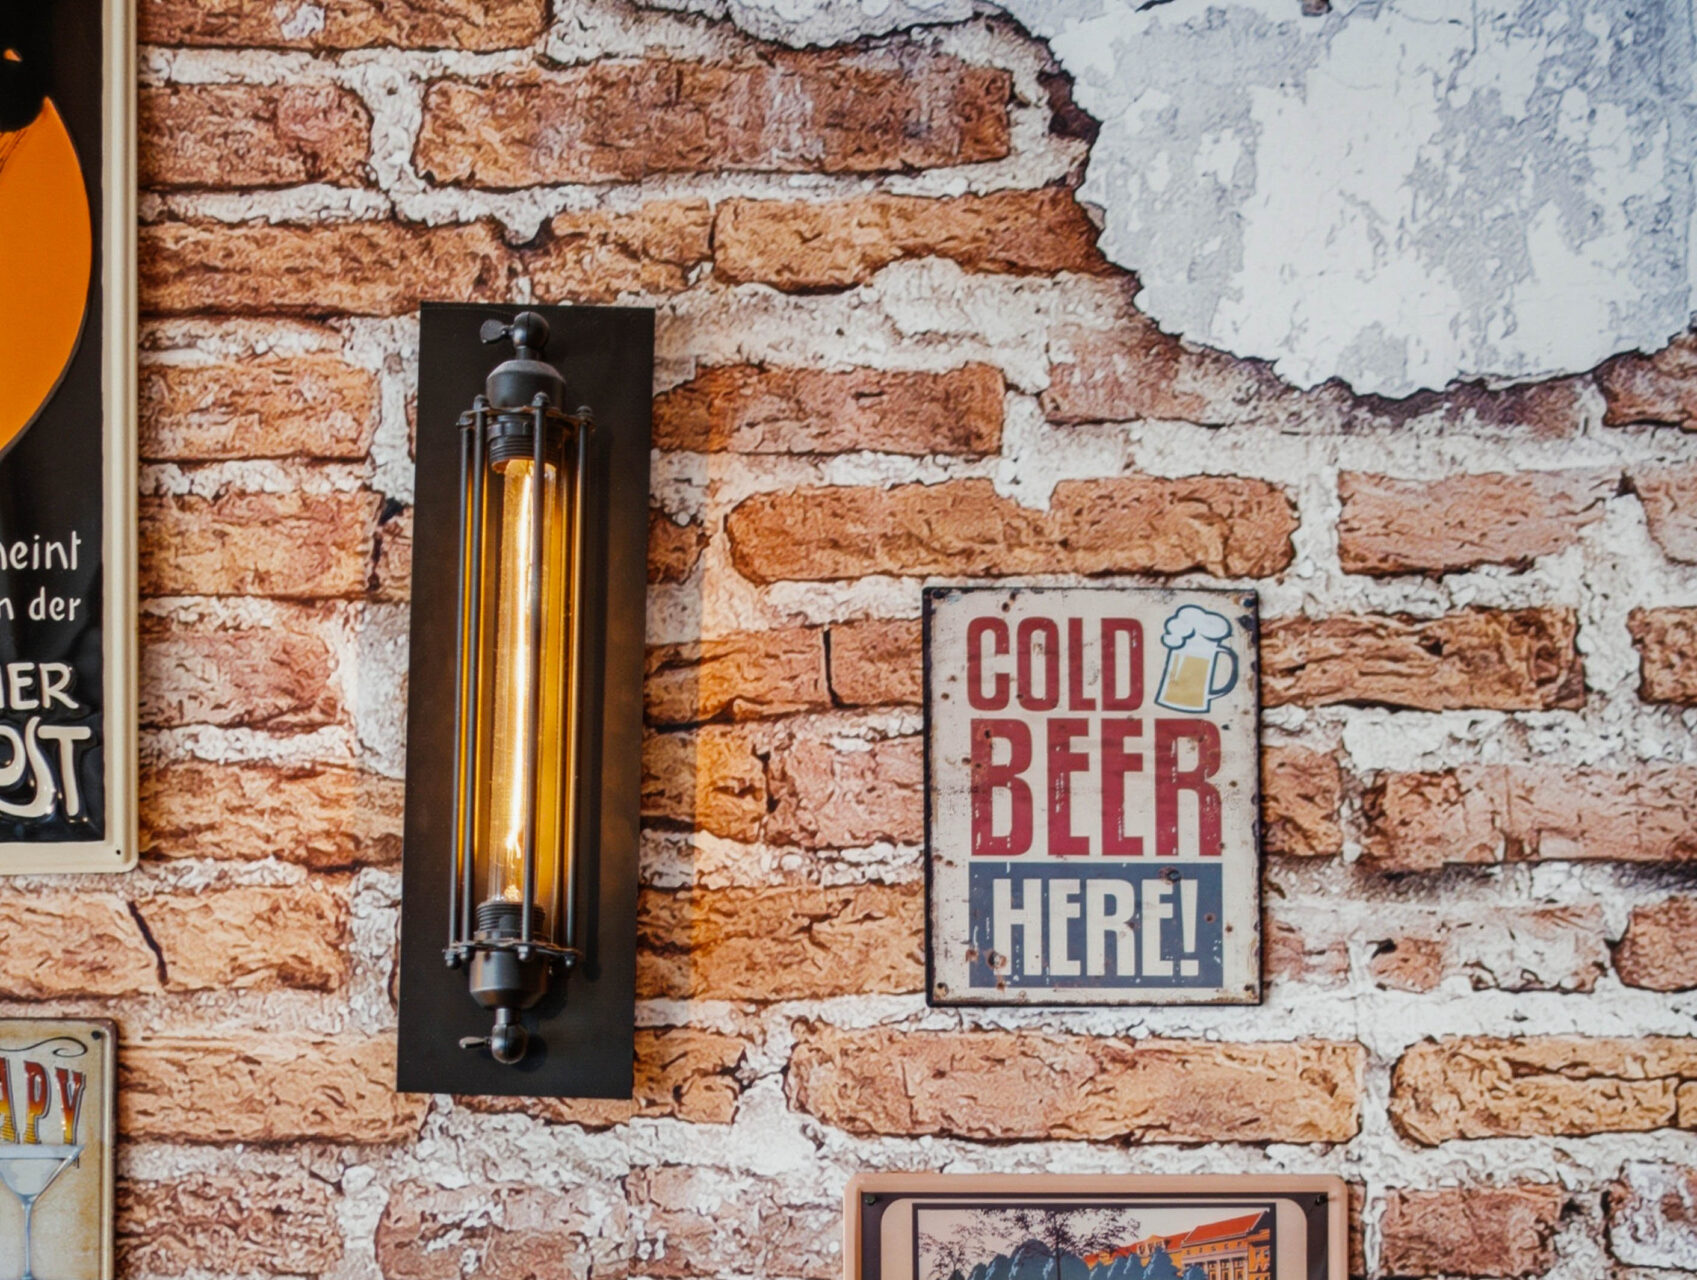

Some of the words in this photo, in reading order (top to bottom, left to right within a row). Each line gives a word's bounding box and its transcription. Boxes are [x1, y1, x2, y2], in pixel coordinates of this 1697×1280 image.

[28, 585, 82, 622] der
[0, 662, 80, 711] ER
[966, 616, 1144, 712] COLD
[970, 717, 1223, 857] BEER
[992, 878, 1200, 977] HERE!
